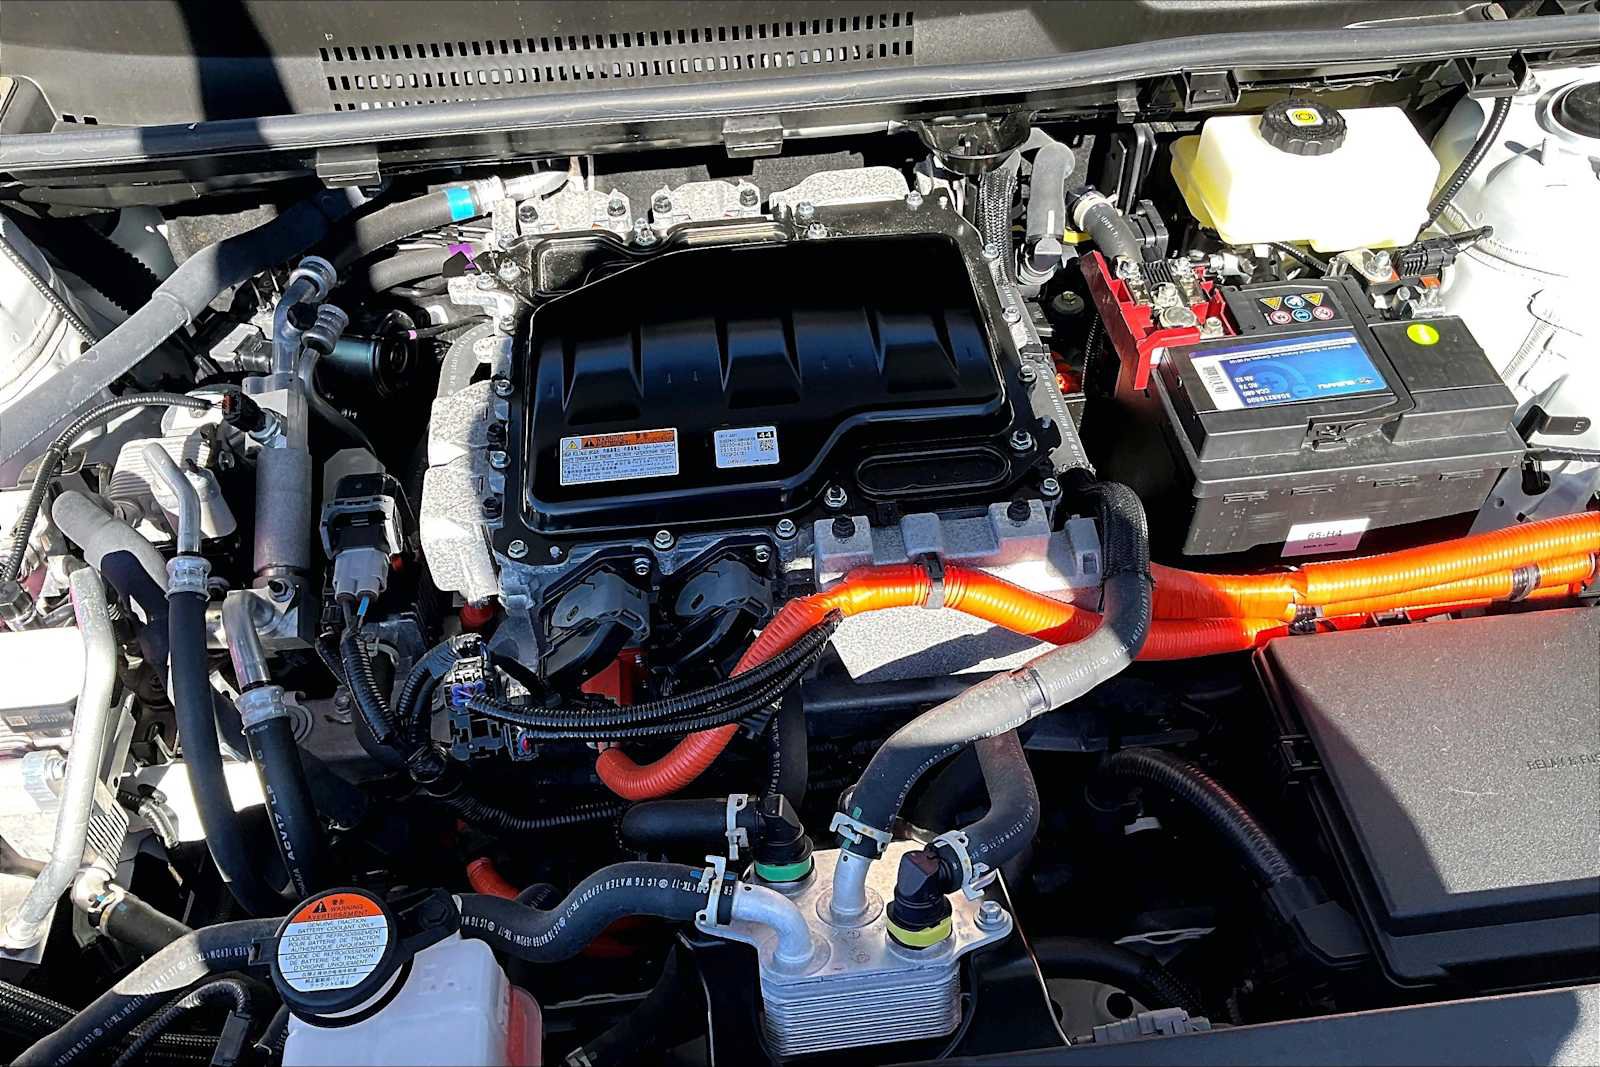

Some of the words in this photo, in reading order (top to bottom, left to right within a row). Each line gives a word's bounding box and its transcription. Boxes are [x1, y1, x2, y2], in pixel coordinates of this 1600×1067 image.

[274, 813, 296, 861] ACV17
[605, 878, 632, 890] WATER
[308, 910, 368, 920] AVERTISSEMENT
[532, 934, 549, 948] WATER
